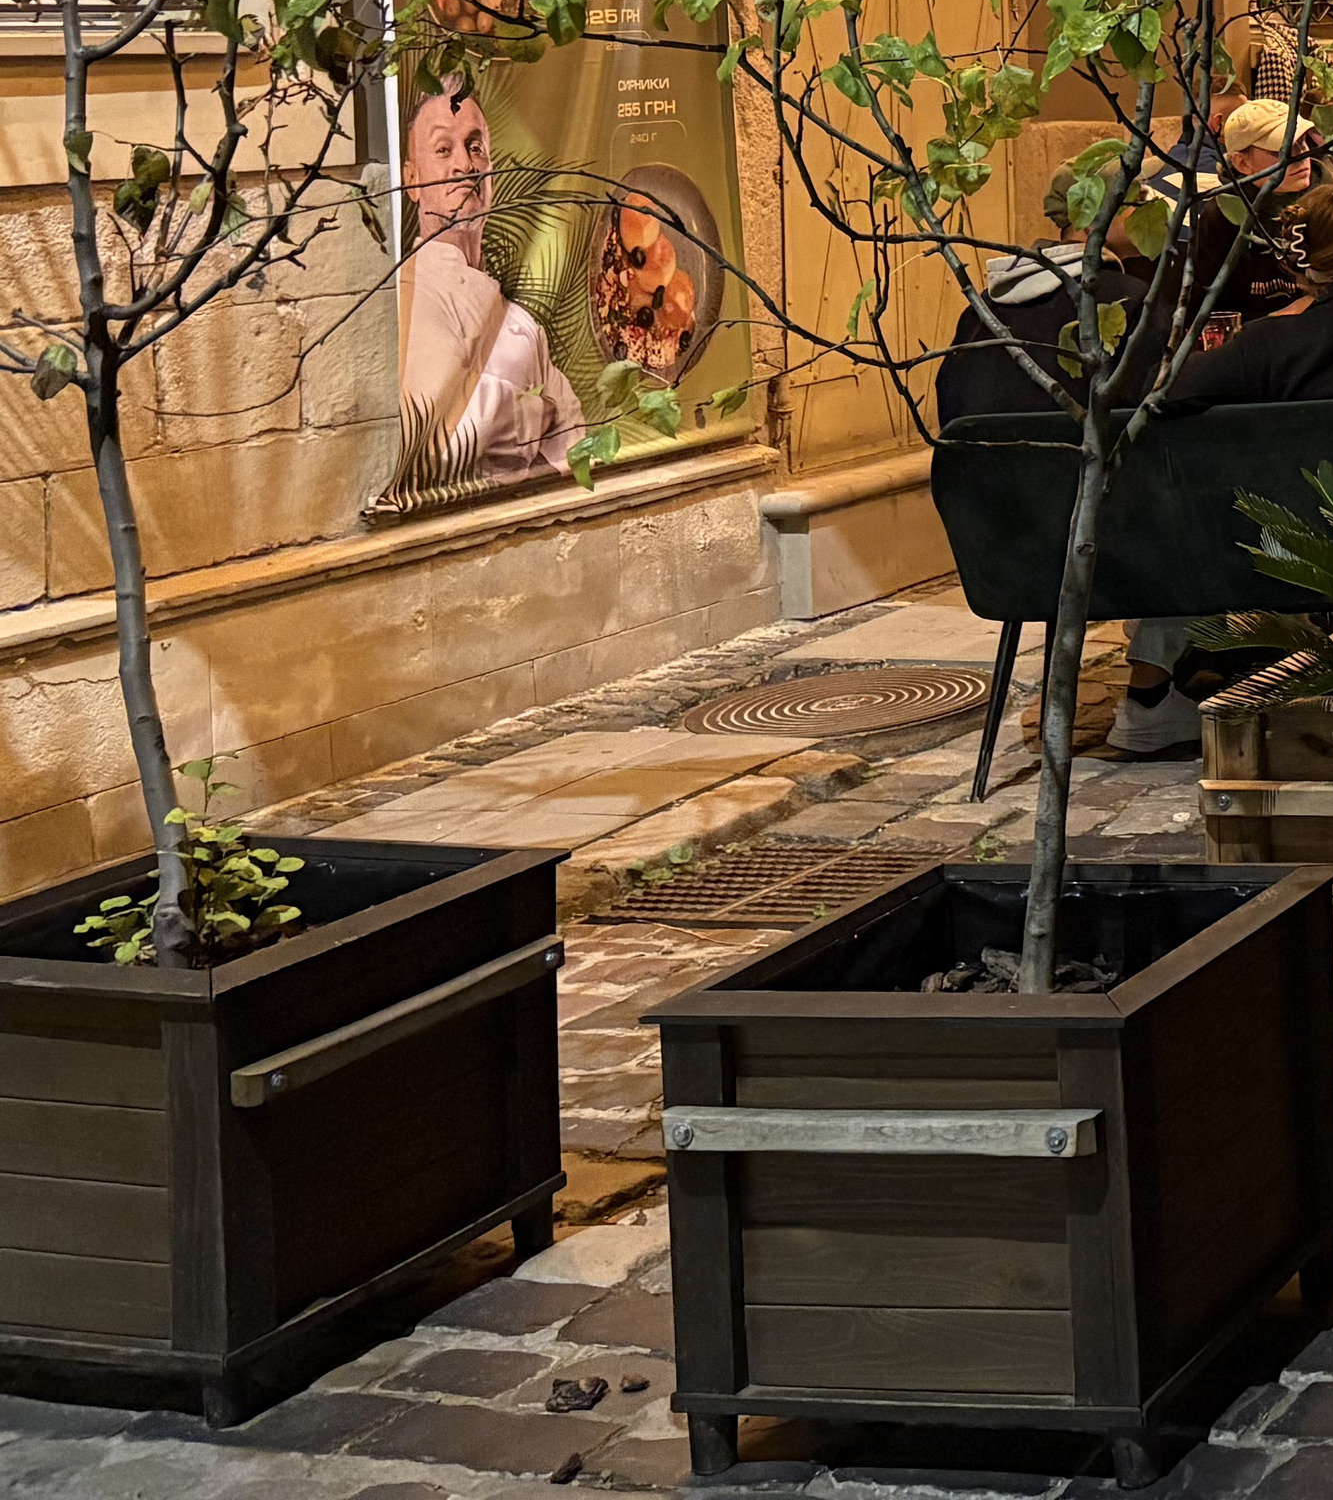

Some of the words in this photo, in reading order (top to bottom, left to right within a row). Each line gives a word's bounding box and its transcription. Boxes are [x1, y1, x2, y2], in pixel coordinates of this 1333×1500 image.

[584, 9, 618, 25] 25
[621, 9, 640, 23] ГРН
[617, 78, 669, 92] СИРНИКИ
[644, 100, 676, 115] ГРН
